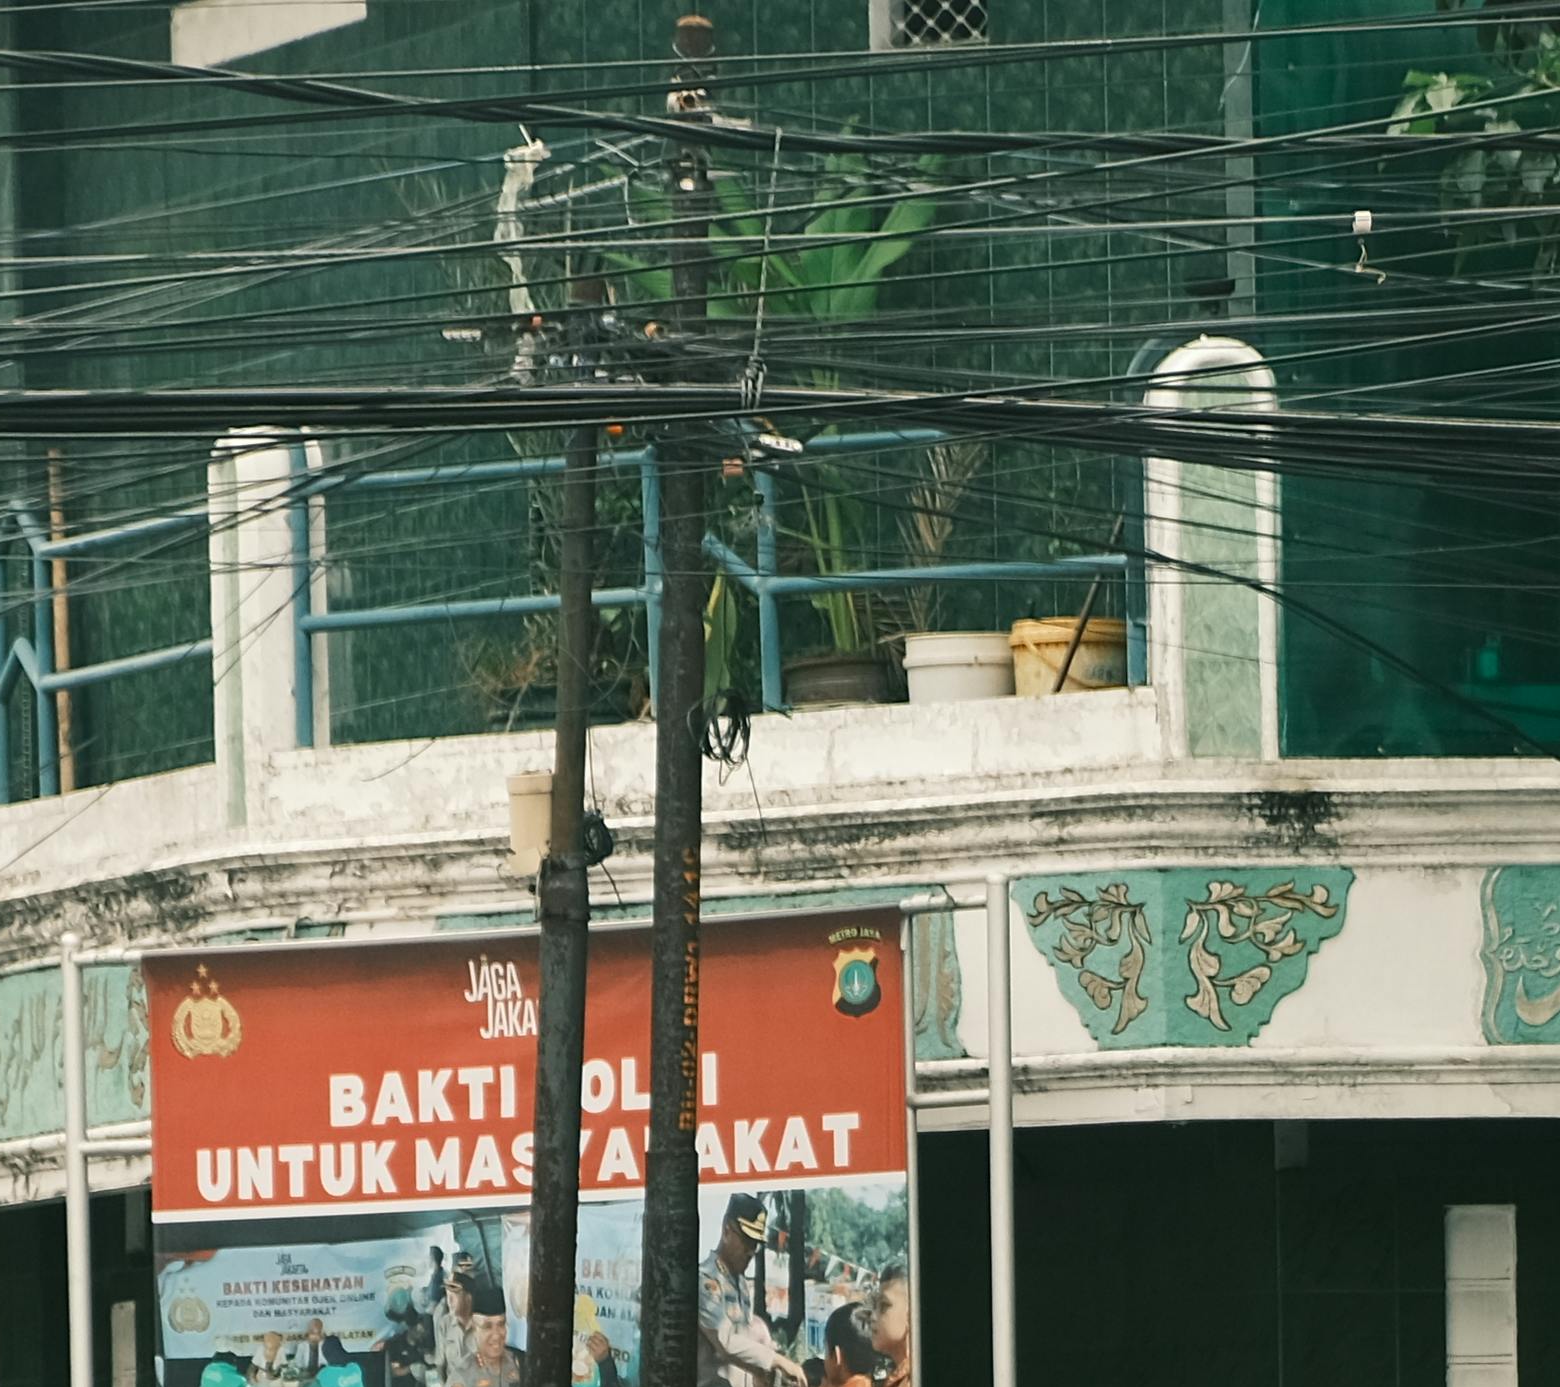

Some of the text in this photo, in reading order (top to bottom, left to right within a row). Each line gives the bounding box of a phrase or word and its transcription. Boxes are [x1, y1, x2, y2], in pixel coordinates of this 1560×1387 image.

[464, 953, 522, 1002] JAGA
[479, 997, 539, 1039] JAKA
[329, 1052, 718, 1128] BAKTI OLI
[196, 1139, 398, 1203] UNTUK
[222, 1275, 365, 1296] BAKTI KESEHATAN
